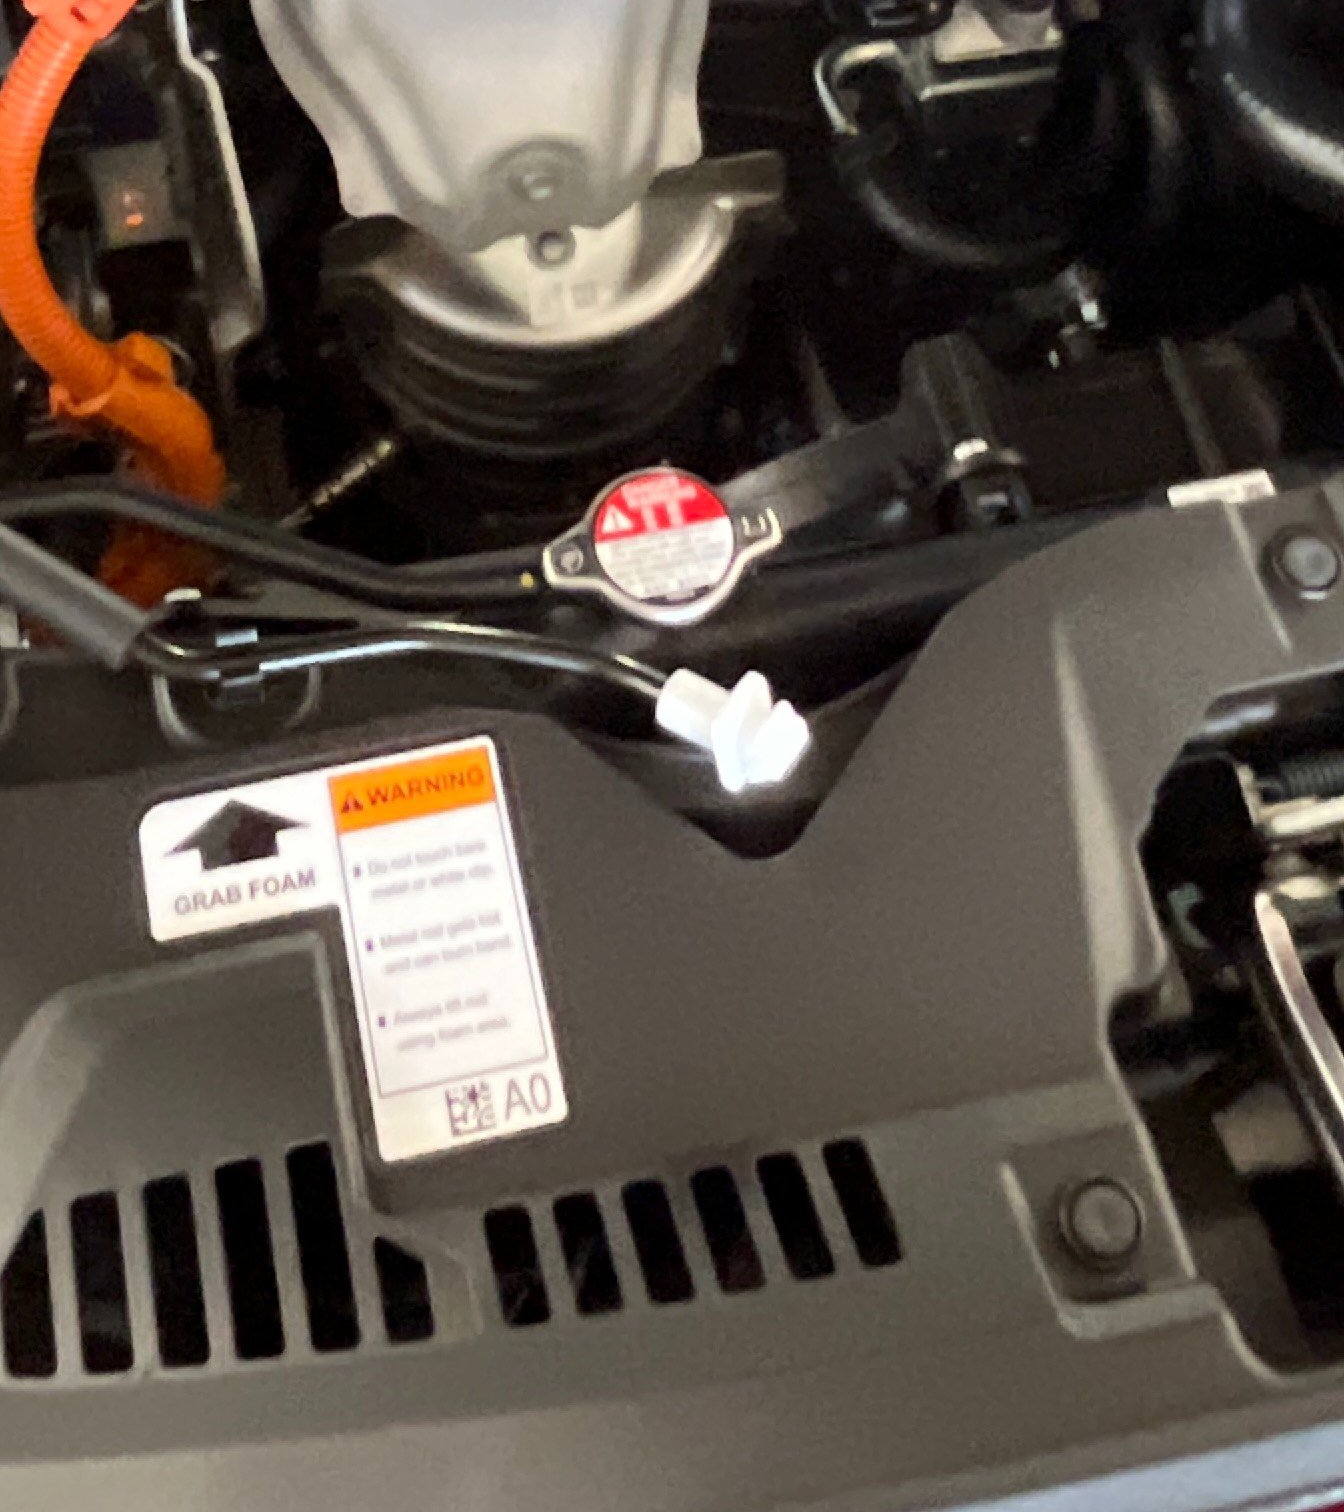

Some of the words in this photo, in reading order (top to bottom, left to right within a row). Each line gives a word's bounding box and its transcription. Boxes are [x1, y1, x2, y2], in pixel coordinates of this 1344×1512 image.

[366, 764, 485, 805] WARNING
[174, 884, 241, 915] GRAB
[249, 866, 316, 900] FOAM
[506, 1073, 552, 1121] A0
